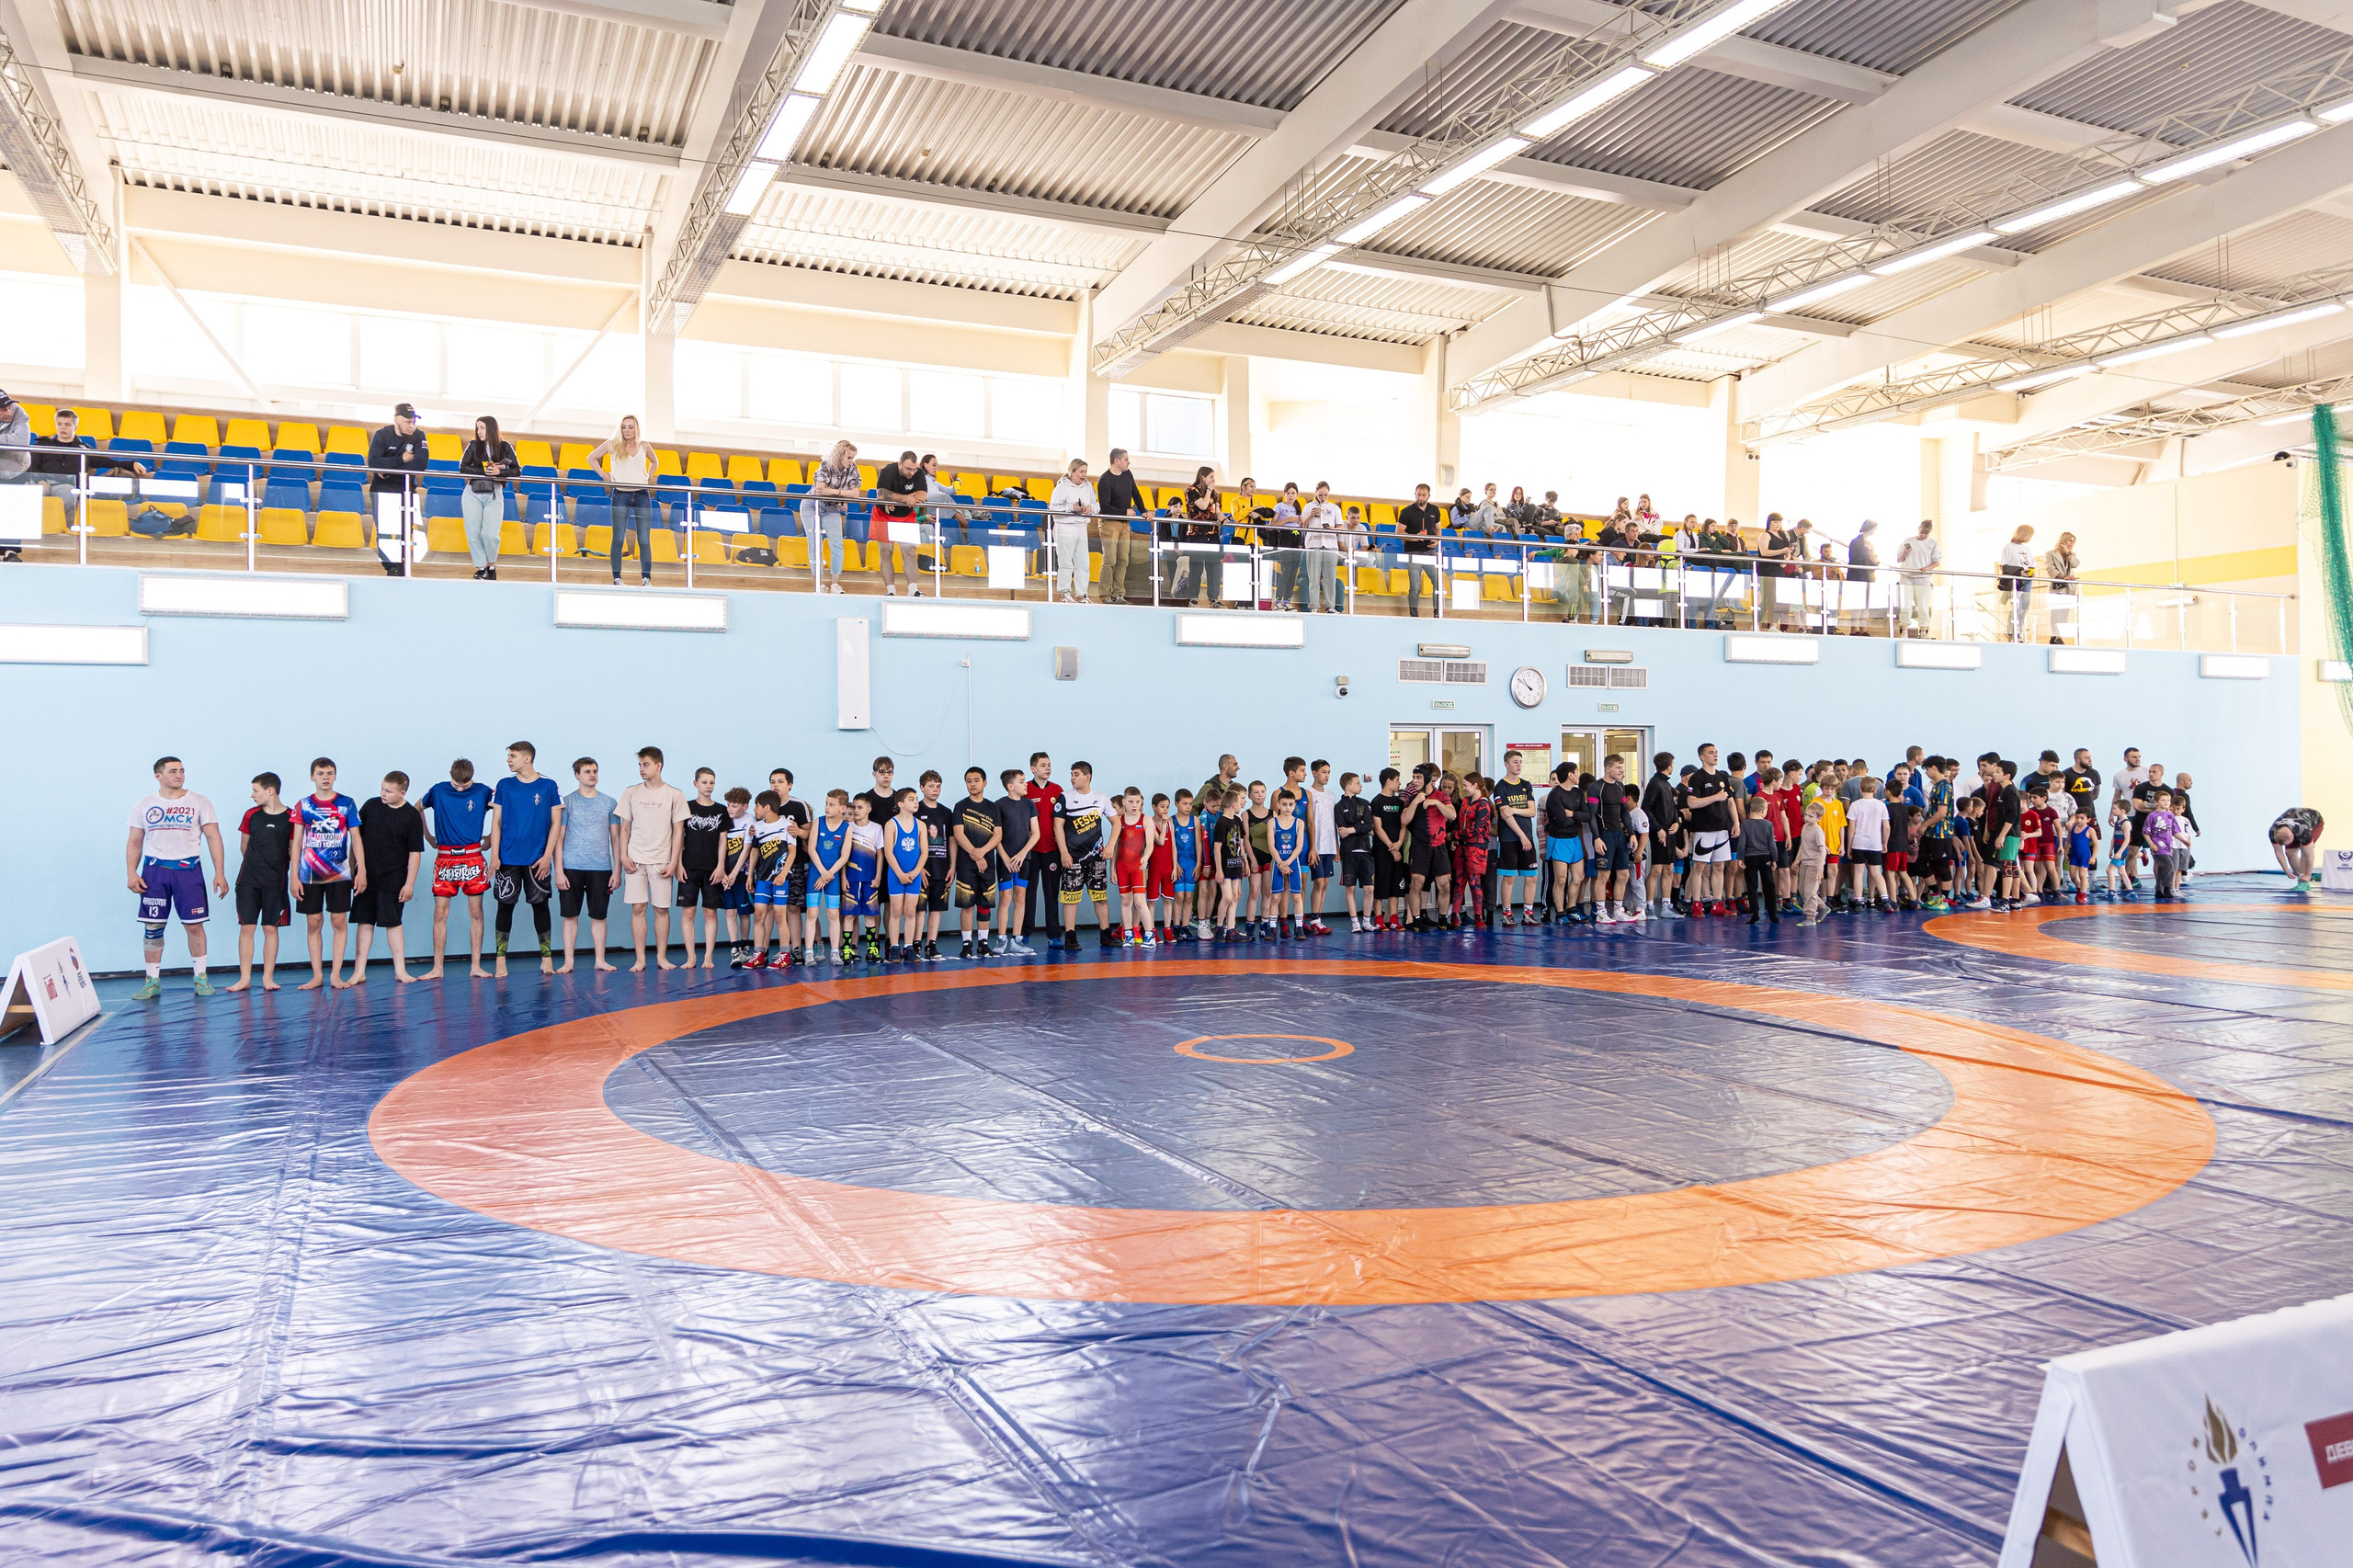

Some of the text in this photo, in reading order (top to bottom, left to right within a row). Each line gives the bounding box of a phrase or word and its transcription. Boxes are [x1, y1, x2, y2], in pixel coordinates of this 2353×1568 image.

[166, 806, 195, 816] #2021
[1073, 809, 1099, 829] FESCO
[727, 835, 744, 849] ESC
[760, 835, 781, 856] FESCO
[149, 906, 159, 918] 13
[2325, 1438, 2353, 1465] ДЕВ
